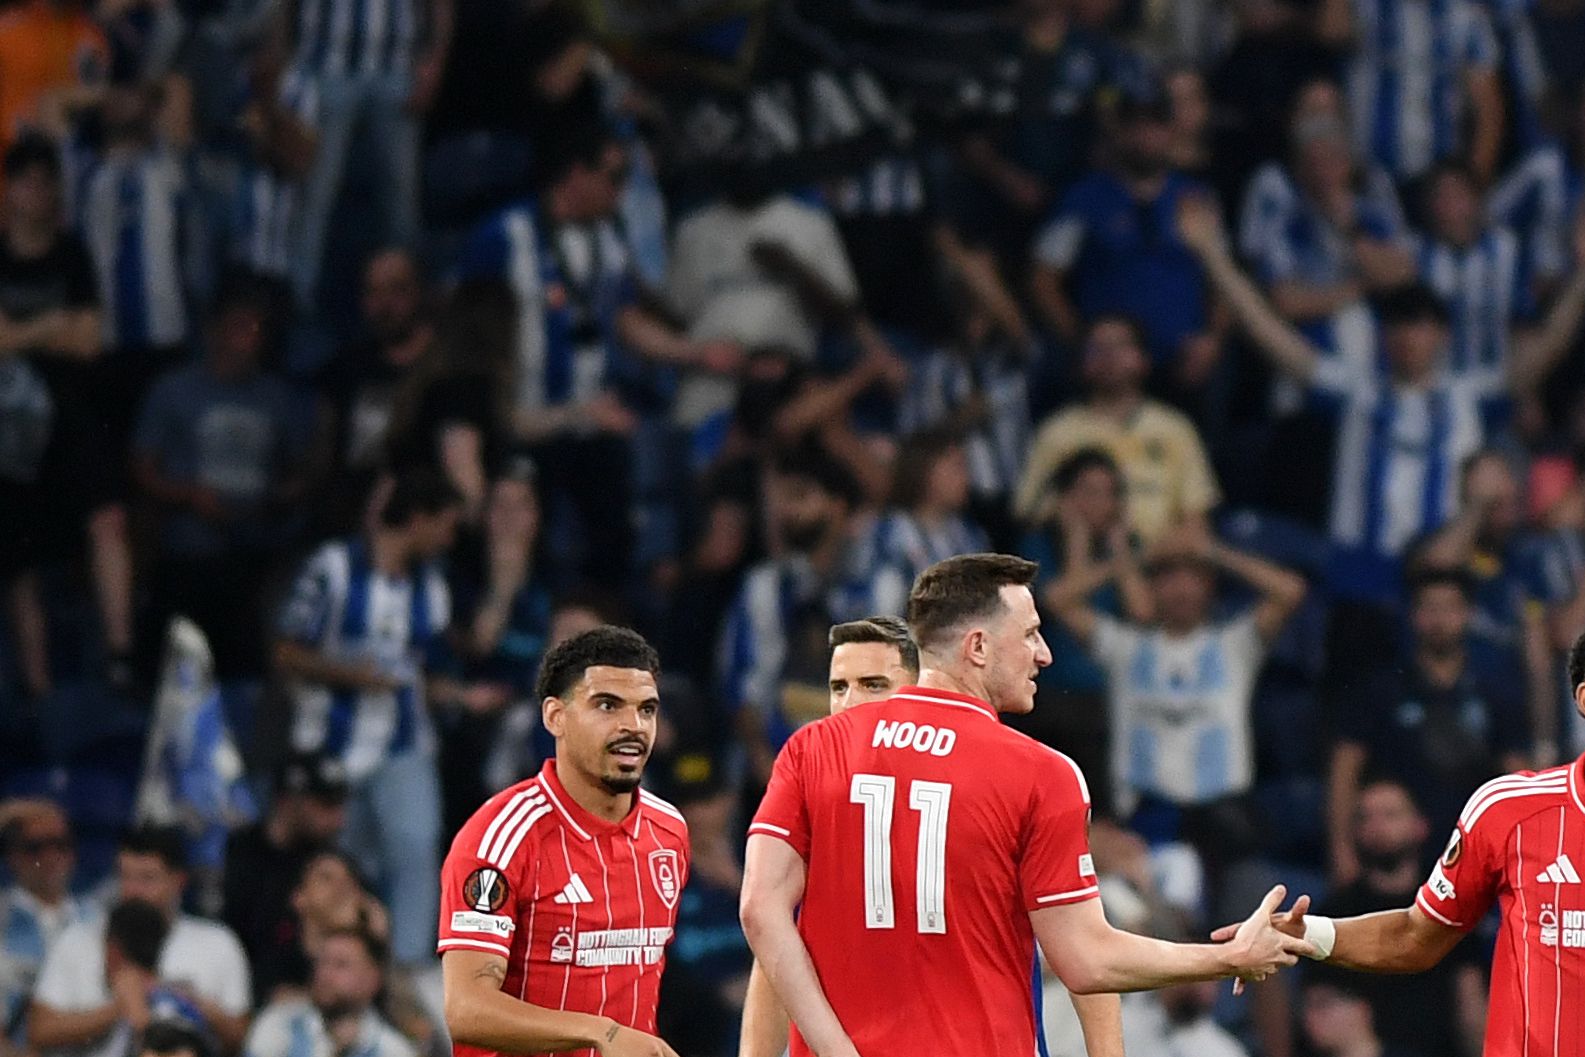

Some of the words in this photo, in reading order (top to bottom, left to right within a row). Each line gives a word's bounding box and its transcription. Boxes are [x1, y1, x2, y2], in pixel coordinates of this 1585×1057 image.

[872, 719, 957, 757] WOOD
[850, 773, 952, 934] 11
[577, 928, 648, 950] NOTTINGHAM
[575, 946, 641, 967] COMMUNITY
